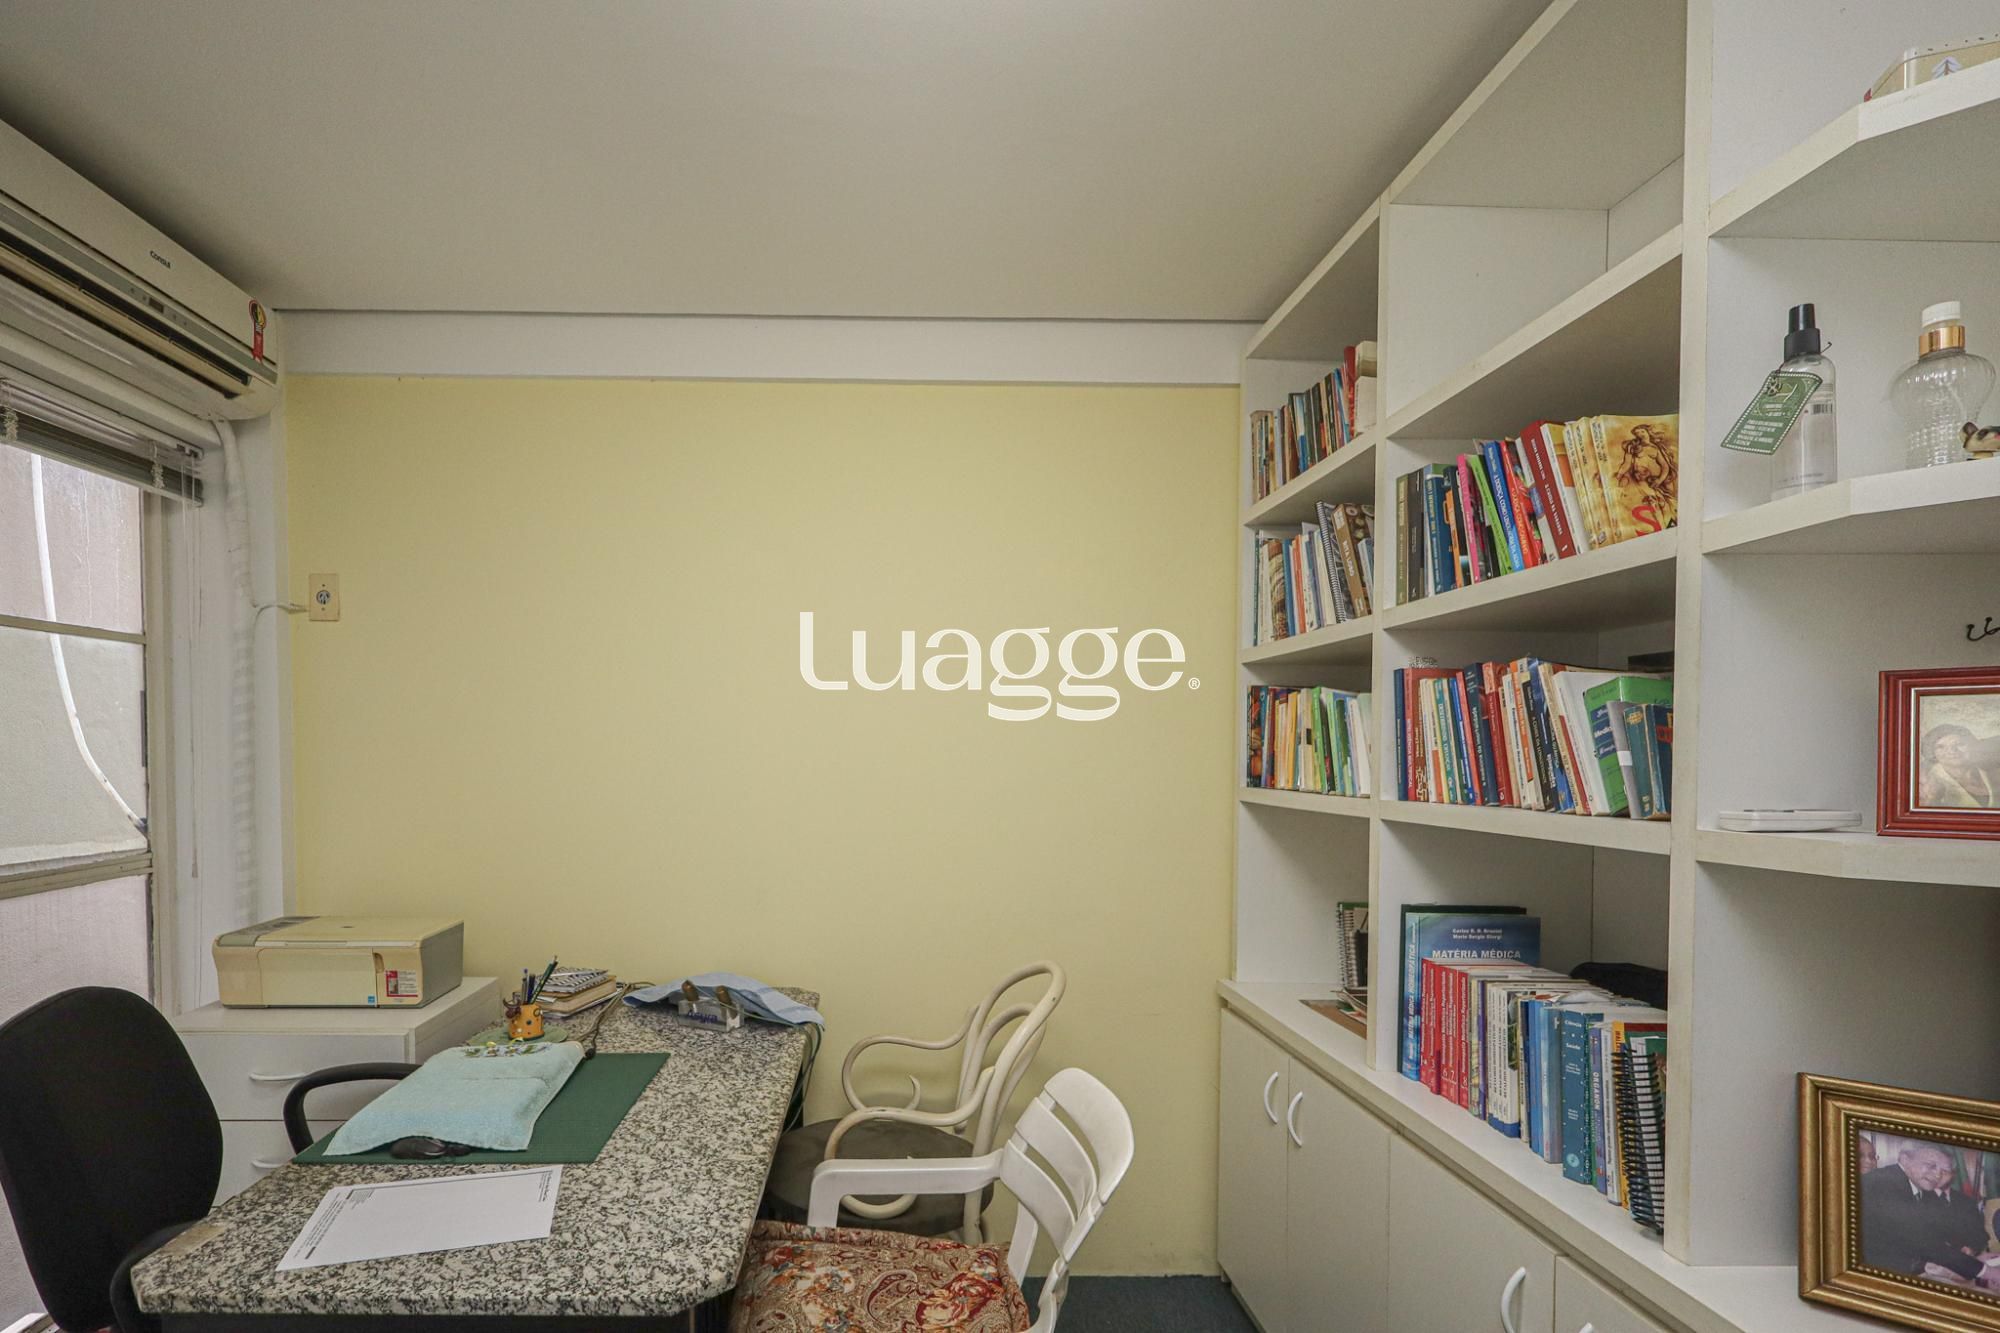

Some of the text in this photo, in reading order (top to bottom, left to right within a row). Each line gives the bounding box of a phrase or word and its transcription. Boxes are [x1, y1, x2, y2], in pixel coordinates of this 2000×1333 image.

[1407, 943, 1415, 993] HOMEOPÁTICA
[1432, 948, 1521, 959] MATÉRIA MÉDICA
[1592, 1071, 1601, 1110] ORGANON
